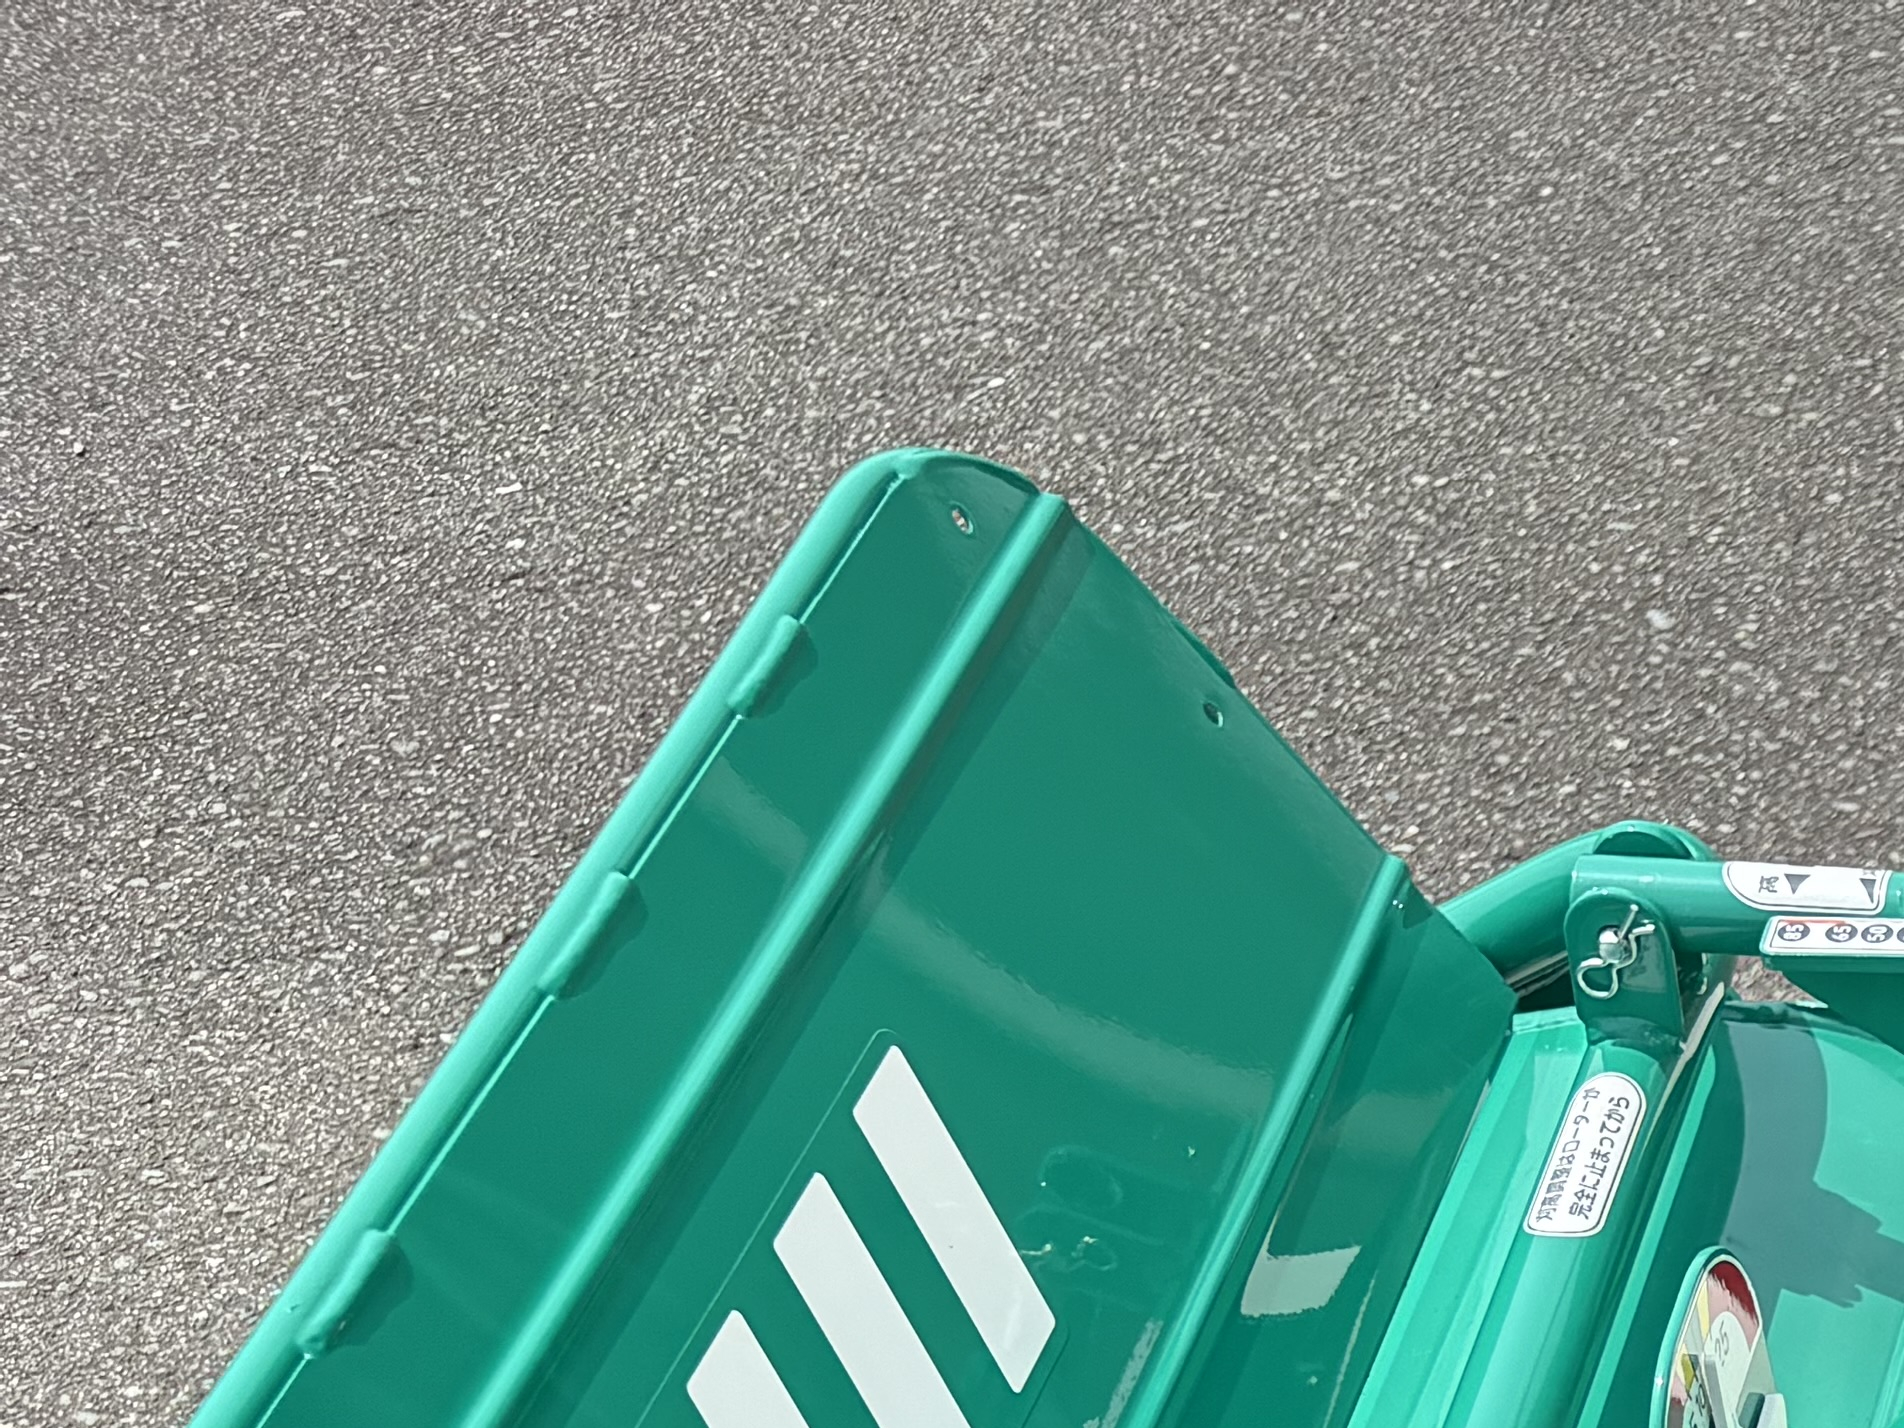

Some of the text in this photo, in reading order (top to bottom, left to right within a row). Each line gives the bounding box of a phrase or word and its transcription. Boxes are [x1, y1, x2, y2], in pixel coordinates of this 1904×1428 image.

[1783, 924, 1804, 940] 85
[1831, 925, 1853, 942] 65
[1867, 925, 1888, 942] 50
[1564, 1093, 1632, 1220] 完全に止まってから
